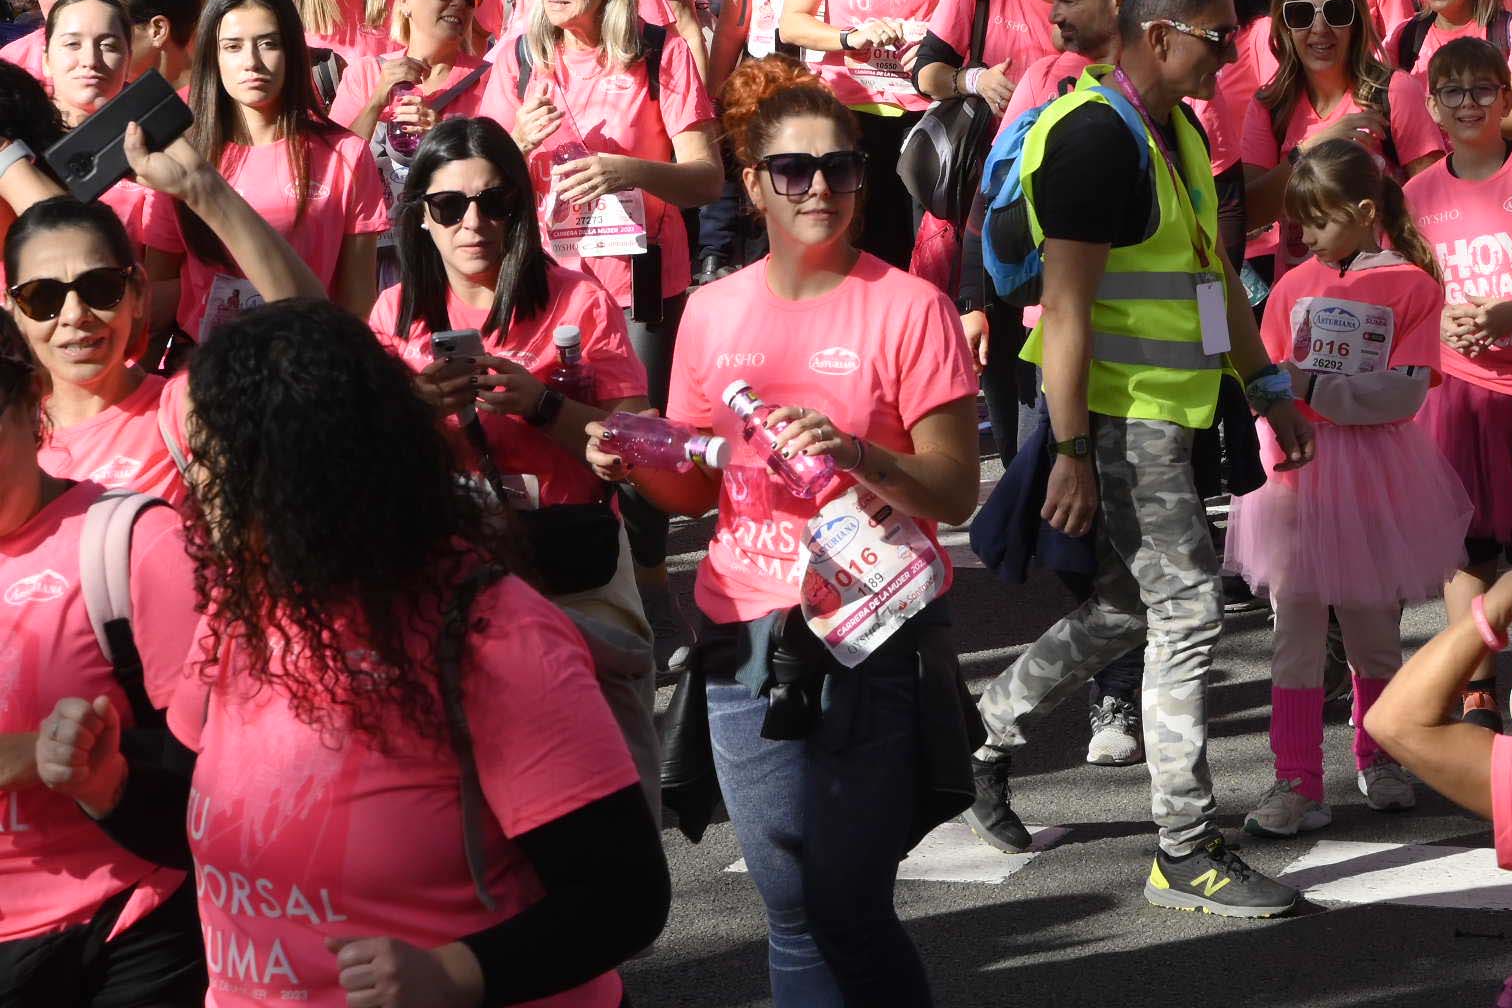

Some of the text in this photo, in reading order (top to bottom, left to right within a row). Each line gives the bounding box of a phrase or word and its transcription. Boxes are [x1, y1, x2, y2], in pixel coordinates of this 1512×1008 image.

[876, 61, 898, 70] 10550
[1312, 339, 1350, 357] 016
[1312, 358, 1343, 371] 26292
[835, 547, 879, 588] 016
[857, 572, 885, 596] 1189
[836, 606, 871, 638] CARRERA
[869, 598, 881, 611] DE
[879, 589, 890, 603] LA
[888, 571, 911, 595] MUJER
